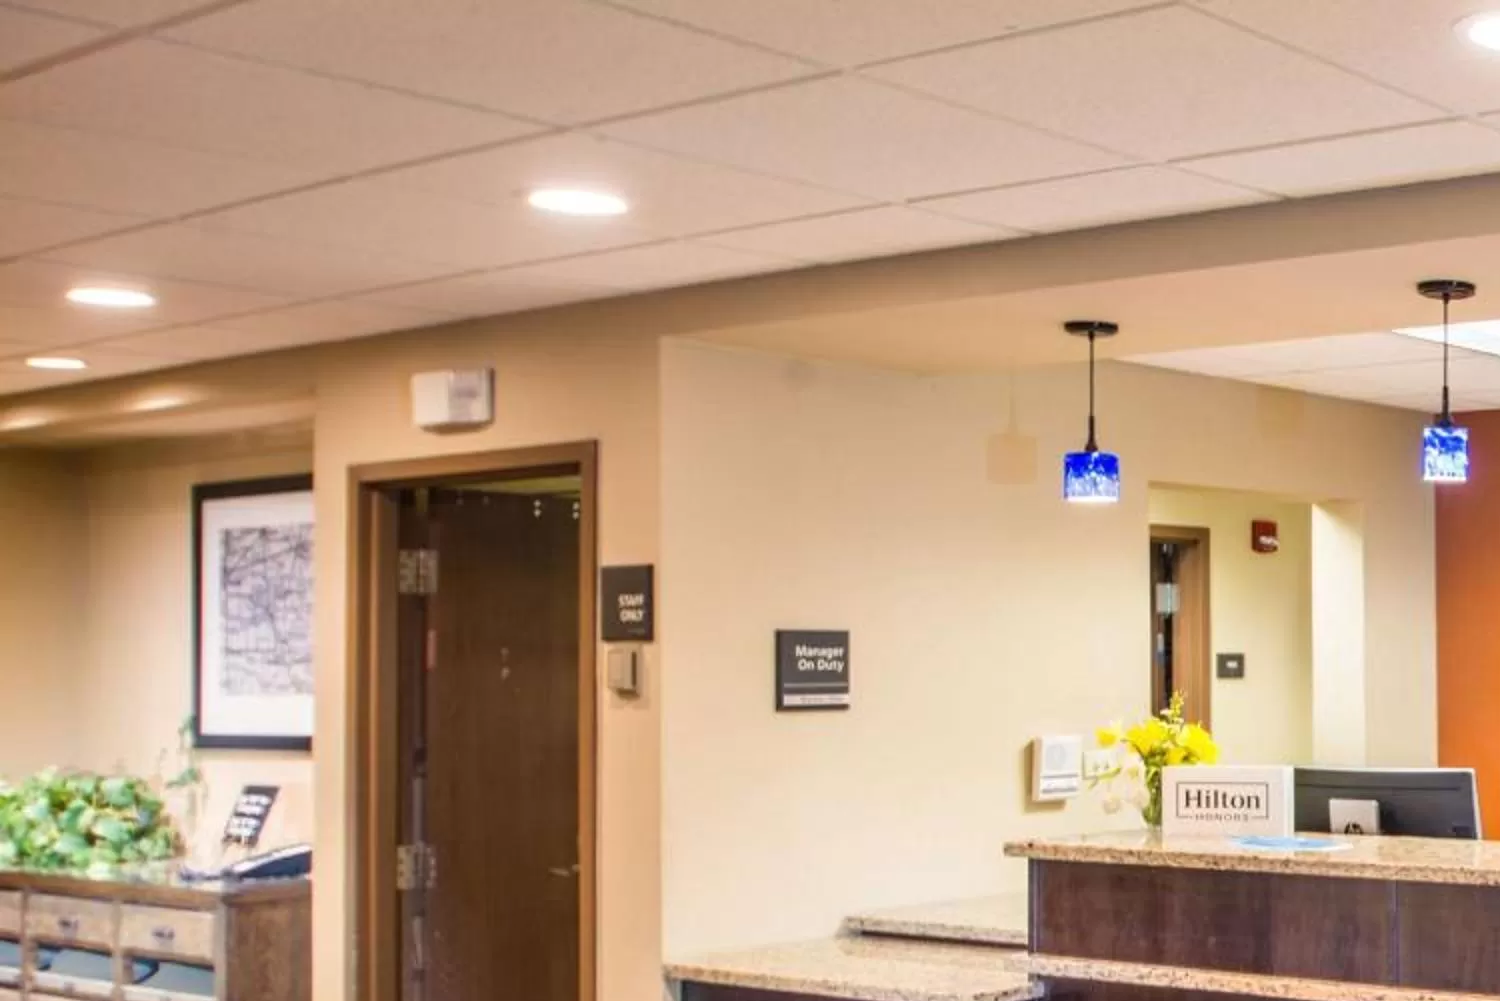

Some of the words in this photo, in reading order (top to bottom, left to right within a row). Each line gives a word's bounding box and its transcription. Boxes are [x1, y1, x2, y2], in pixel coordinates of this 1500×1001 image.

[617, 594, 644, 607] STAFF
[620, 609, 644, 622] ONLY
[795, 645, 844, 660] Manager
[798, 658, 815, 671] On
[817, 659, 845, 673] Duty
[1184, 789, 1261, 810] Hilton
[1194, 813, 1249, 822] HONORS
